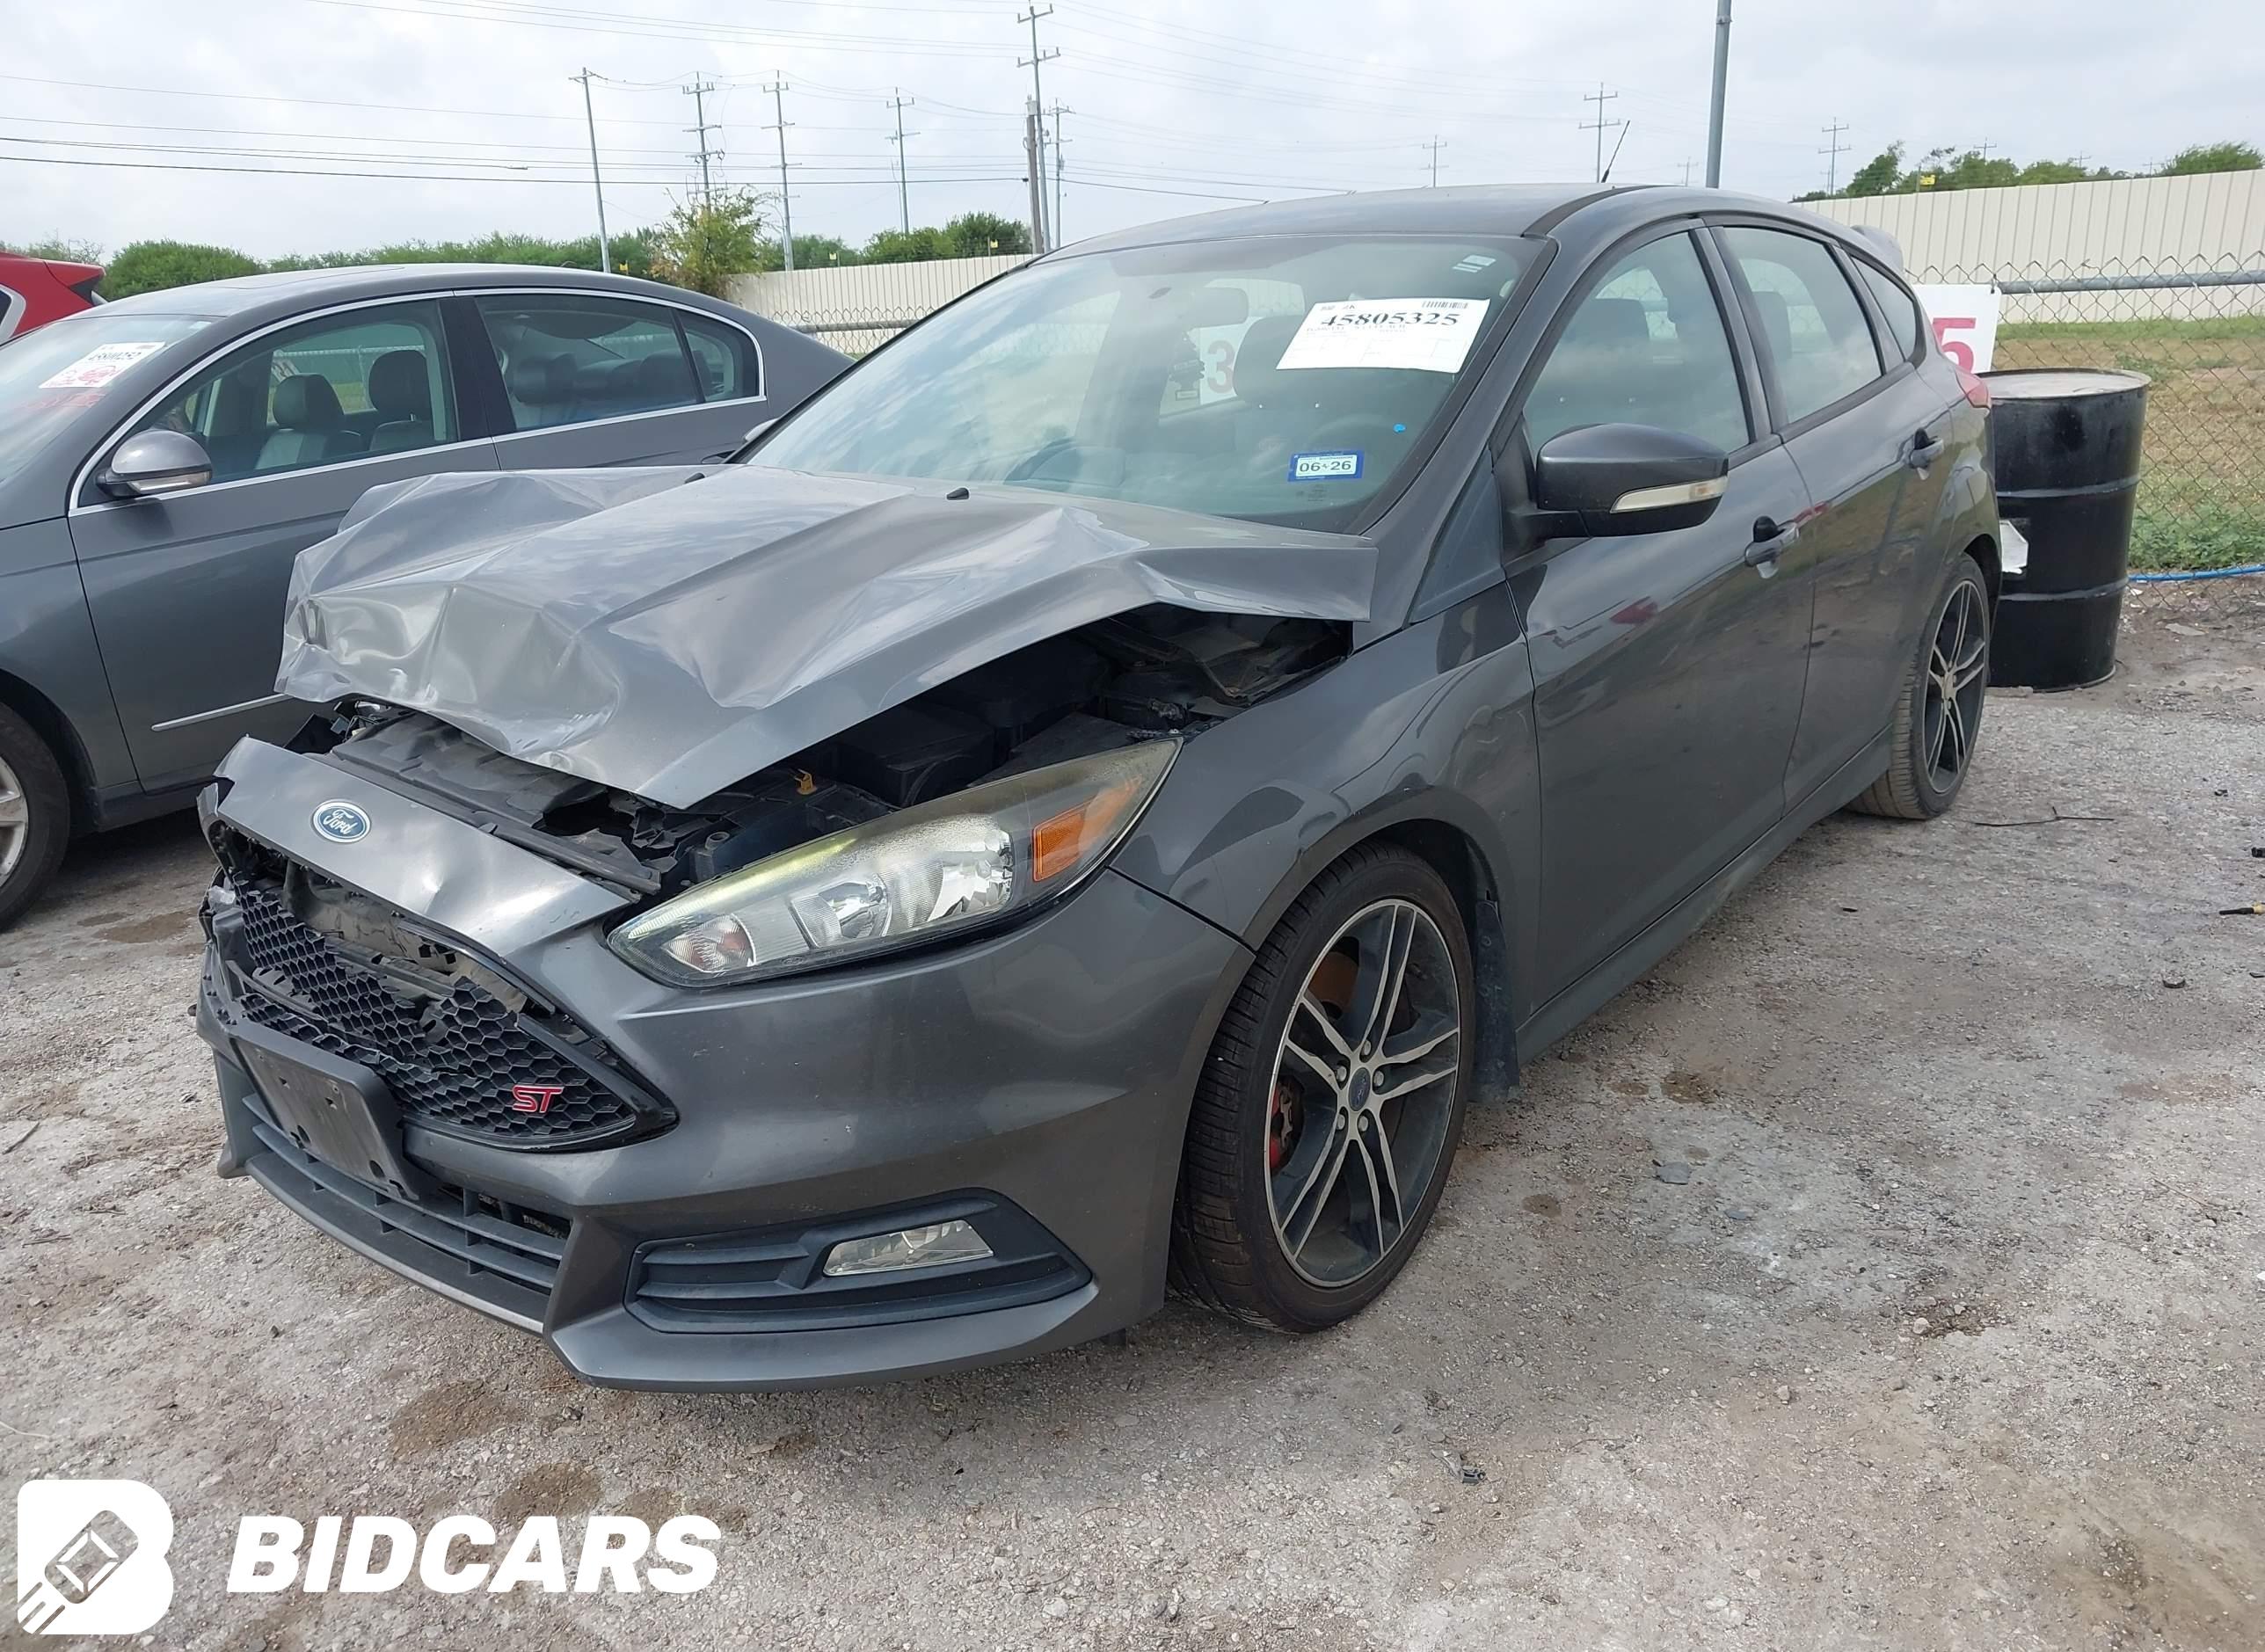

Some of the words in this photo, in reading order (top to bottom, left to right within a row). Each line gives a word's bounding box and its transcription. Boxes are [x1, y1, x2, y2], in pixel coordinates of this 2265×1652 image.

[1321, 312, 1460, 326] 45805325
[1933, 317, 1976, 373] 5
[1207, 339, 1234, 394] 3
[323, 809, 359, 834] Ford
[512, 1084, 564, 1113] ST
